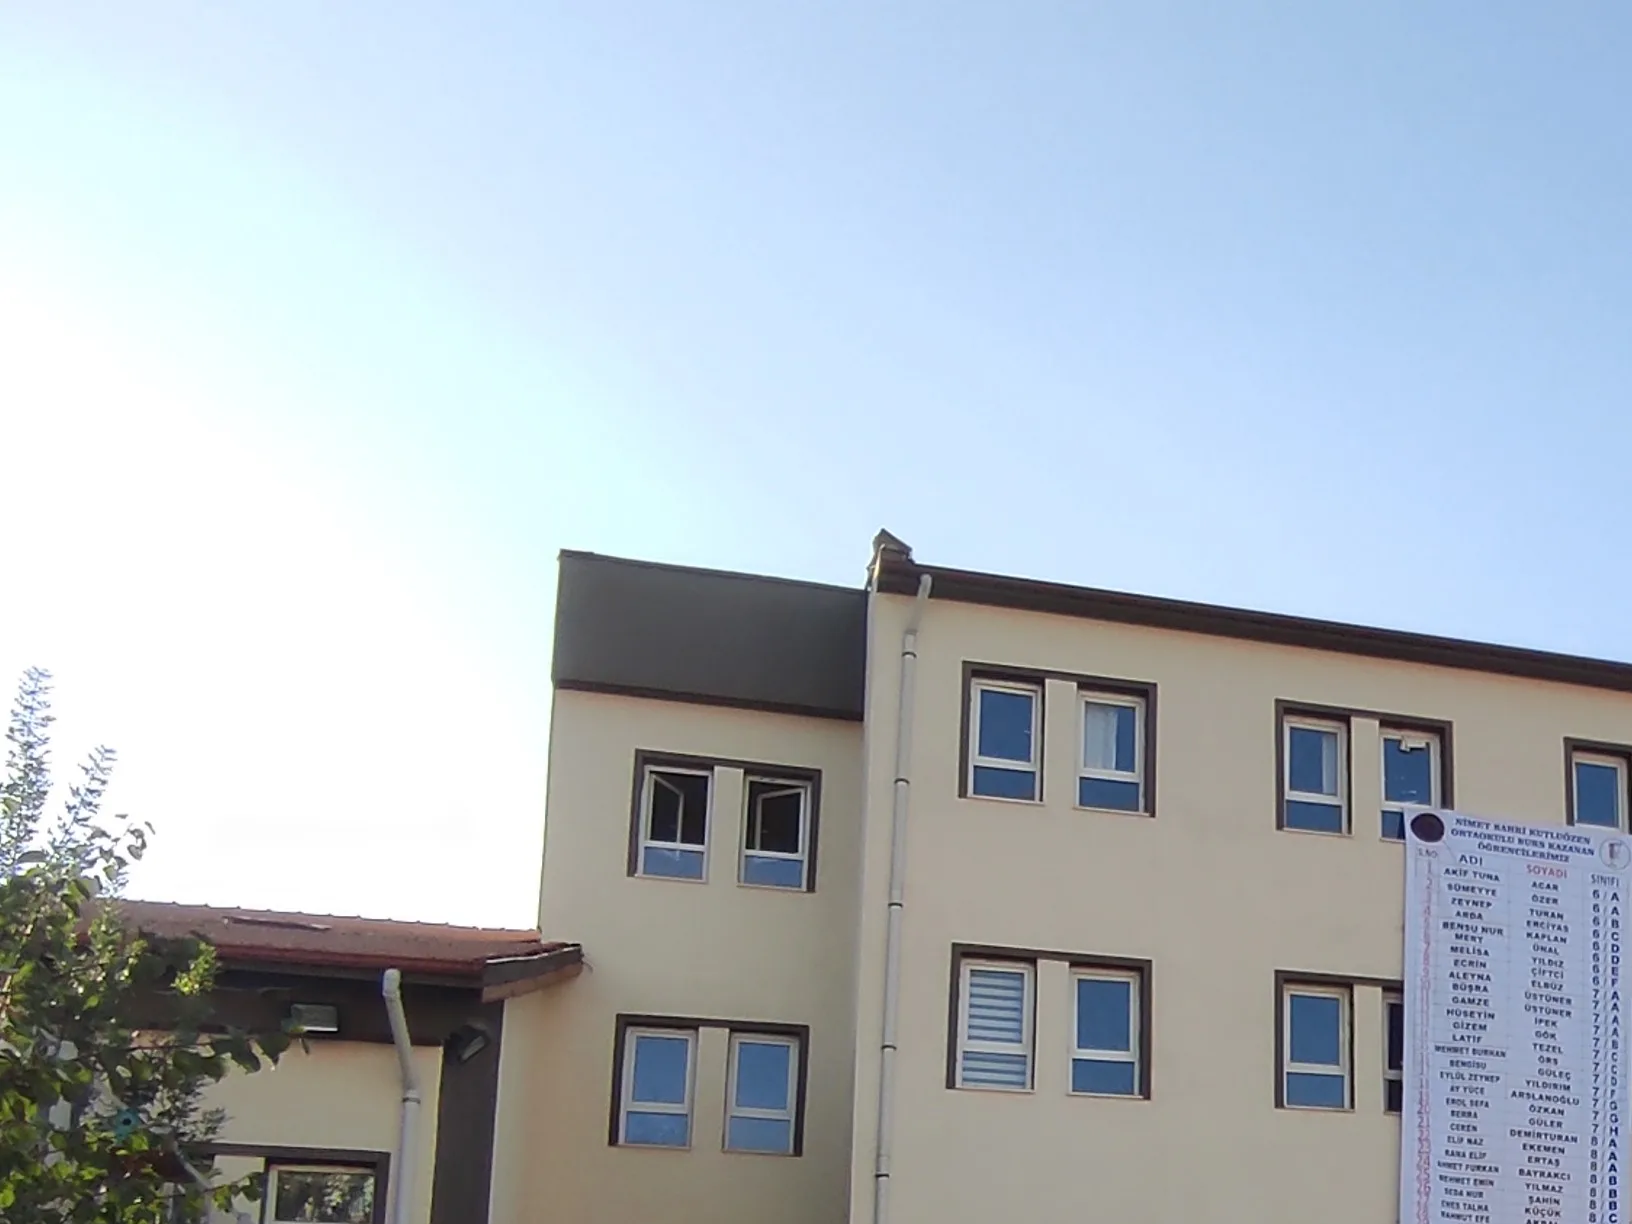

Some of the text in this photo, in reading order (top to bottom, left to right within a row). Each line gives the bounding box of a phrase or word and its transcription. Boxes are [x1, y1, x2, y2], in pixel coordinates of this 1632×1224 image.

[1455, 816, 1489, 829] NİMET
[1529, 827, 1590, 845] KUTLUÖZEN
[1450, 827, 1594, 856] ORTAOKULU BURS KAZANAN
[1478, 840, 1569, 863] ÖĞRENCİLERİMİZ
[1459, 854, 1482, 865] ADI
[1531, 880, 1558, 892] ACAR
[1531, 893, 1558, 905] ÖZER
[1528, 908, 1563, 920] TURAN
[1525, 931, 1567, 944] KAPLAN
[1532, 943, 1559, 955] ÜNAL
[1531, 956, 1564, 968] YILDIZ
[1524, 990, 1572, 1005] ÜSTÜNER
[1523, 1003, 1572, 1018] ÜSTÜNER
[1534, 1029, 1556, 1040] GÖK
[1532, 1043, 1563, 1054] TEZEL
[1537, 1055, 1558, 1065] ÖRS
[1525, 1079, 1570, 1092] YILDIRIM
[1510, 1089, 1579, 1105] ARSLANOĞLU
[1528, 1104, 1564, 1116] ÖZKAN
[1528, 1116, 1563, 1128] GÜLER
[1509, 1127, 1578, 1143] DEMİRTURAN
[1524, 1182, 1563, 1193] YILMAZ
[1527, 1194, 1560, 1206] ŞAHİN
[1524, 1205, 1561, 1218] KÜÇÜK
